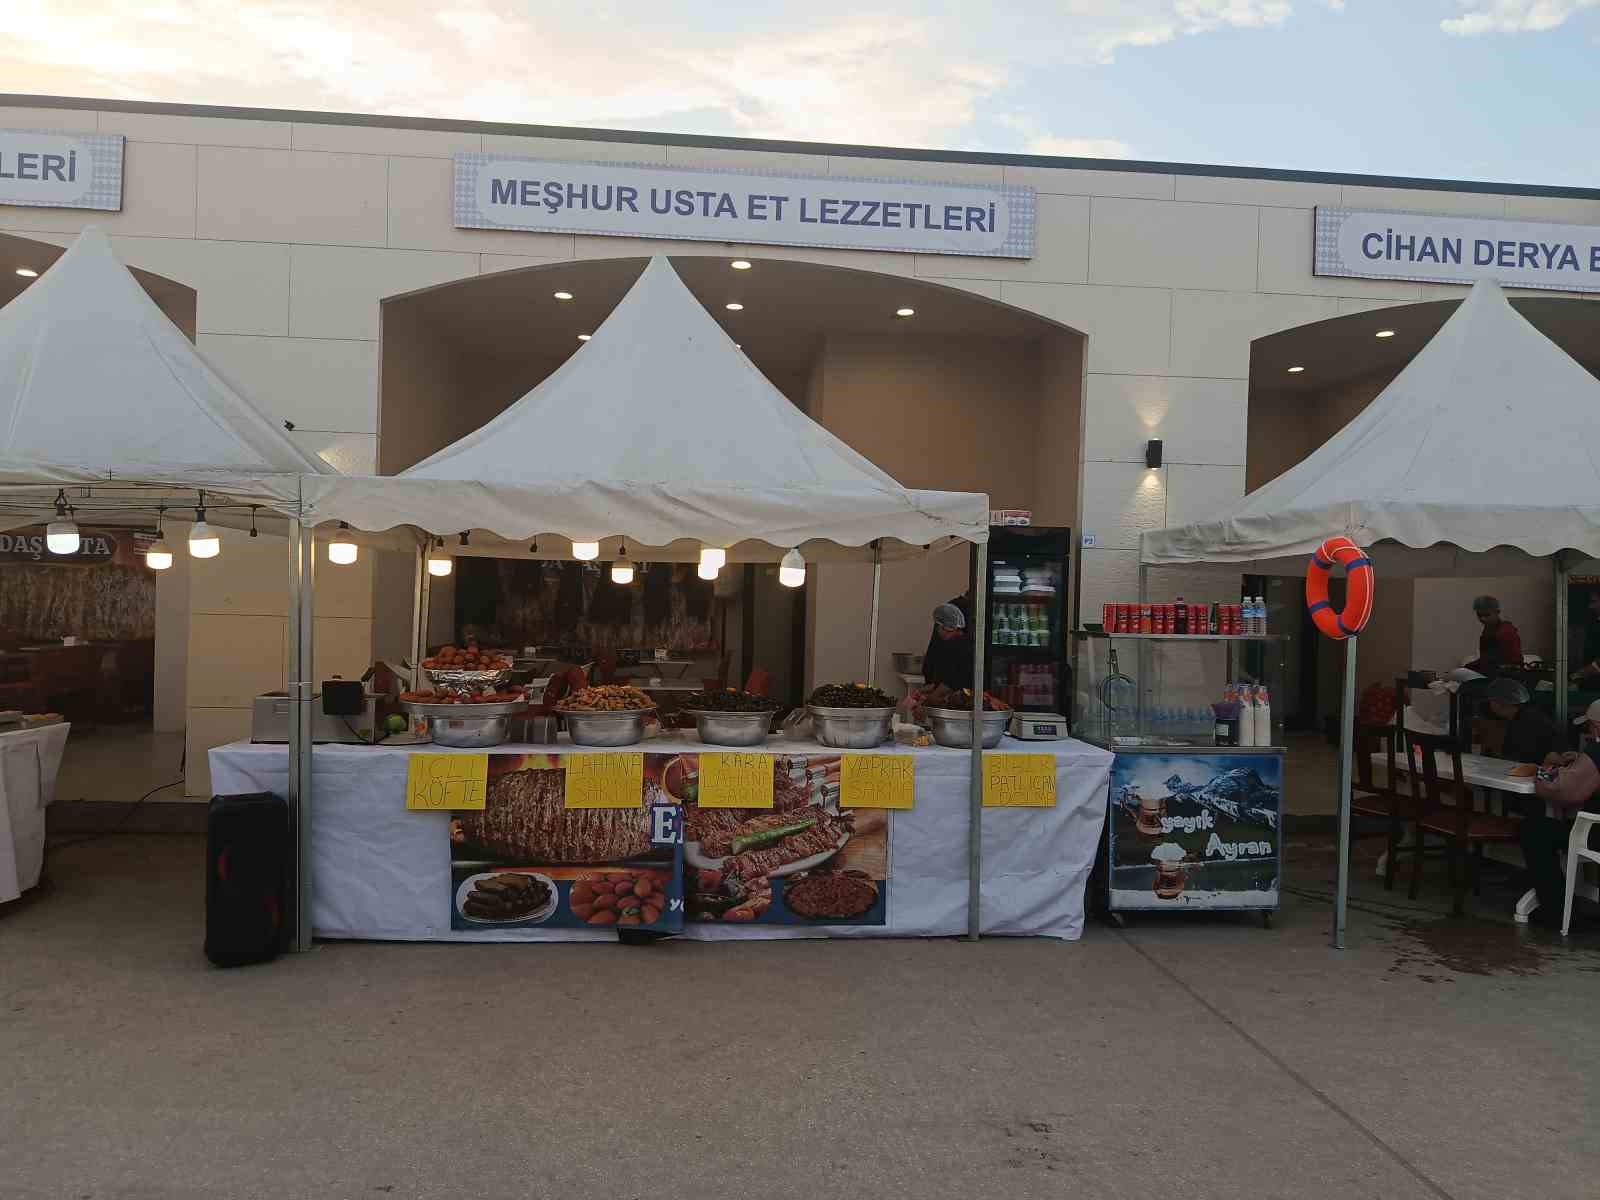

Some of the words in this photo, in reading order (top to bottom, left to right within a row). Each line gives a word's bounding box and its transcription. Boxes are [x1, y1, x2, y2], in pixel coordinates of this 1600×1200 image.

[491, 178, 639, 214] MEŞHUR
[650, 188, 738, 219] USTA
[747, 194, 789, 221] ET
[799, 197, 996, 233] LEZZETLERİ
[1361, 227, 1462, 265] CİHAN
[1473, 239, 1580, 272] DERYA
[1205, 833, 1272, 860] Ayran
